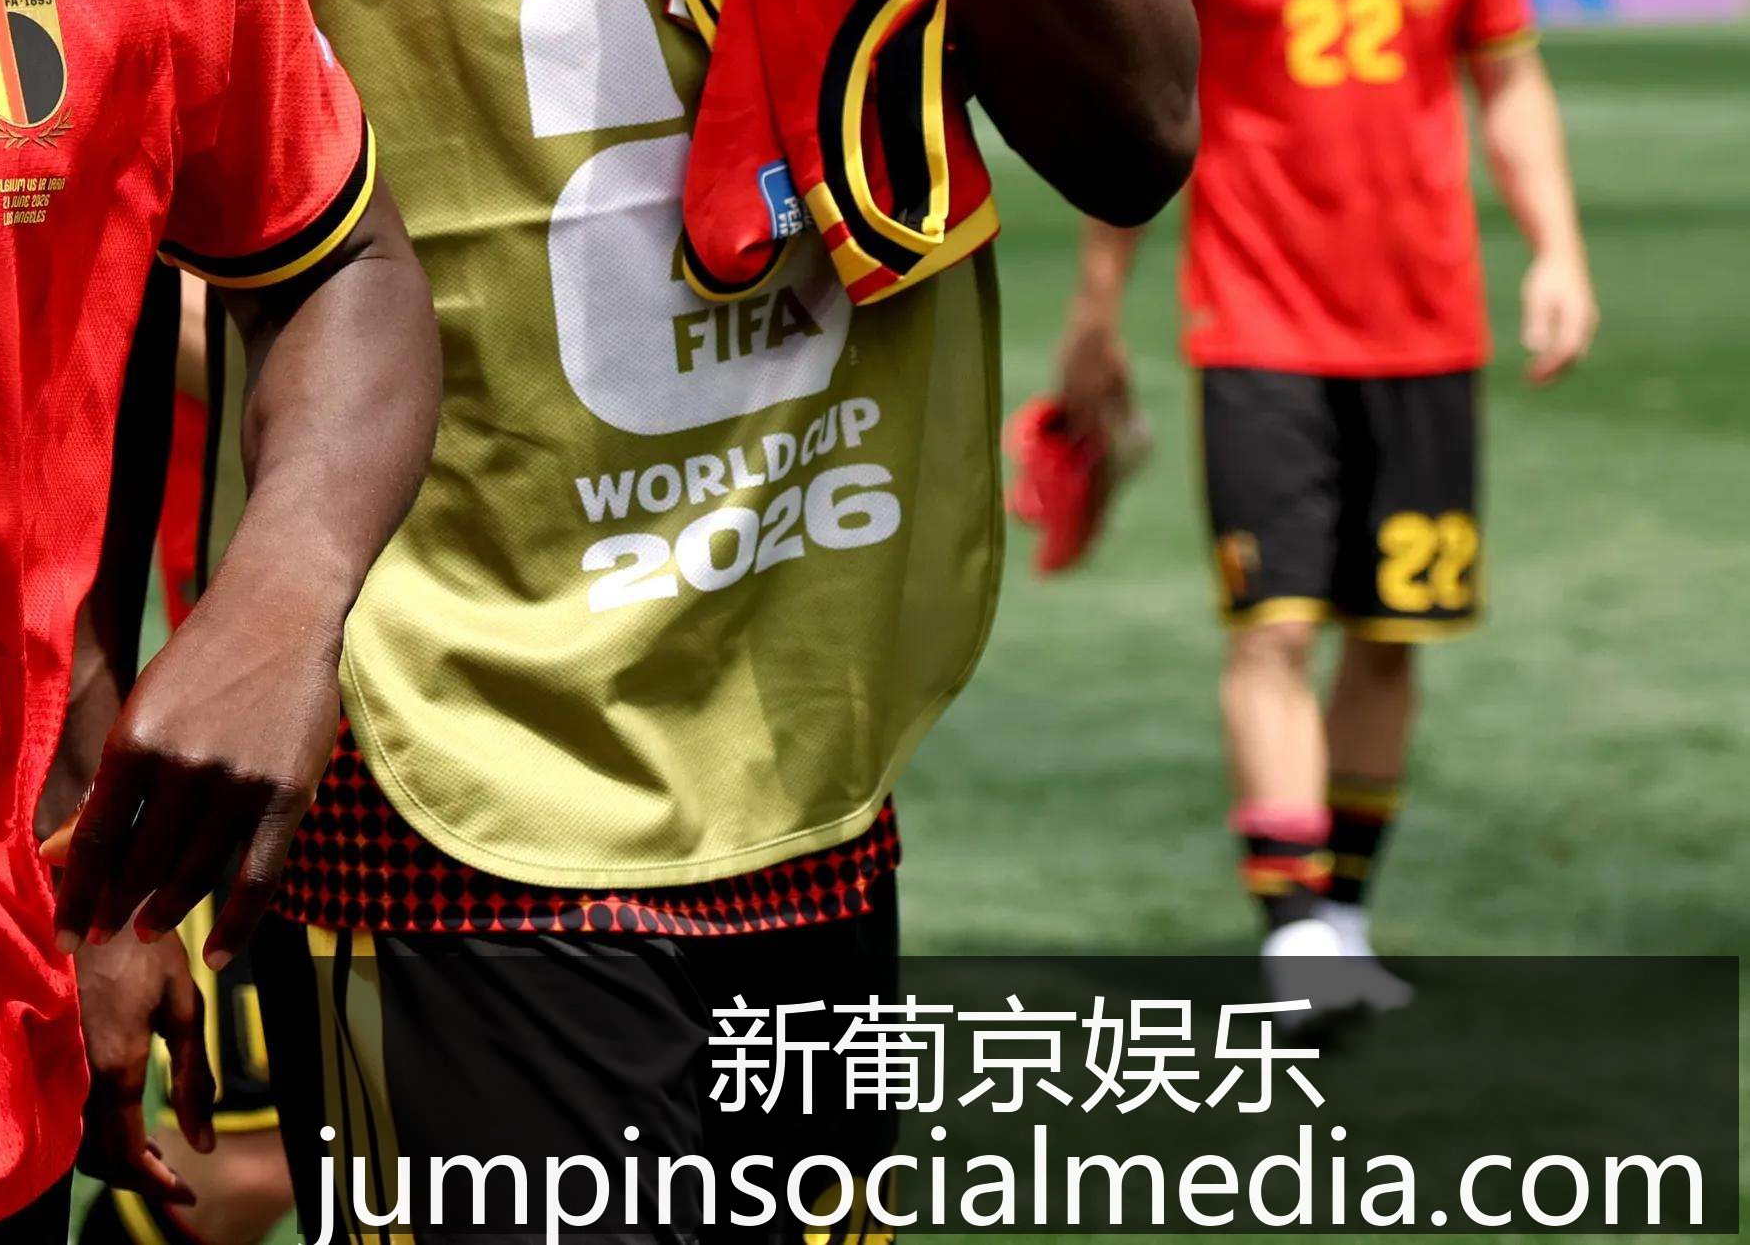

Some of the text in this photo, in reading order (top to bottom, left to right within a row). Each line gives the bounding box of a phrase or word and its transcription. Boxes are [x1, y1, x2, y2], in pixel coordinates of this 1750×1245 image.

[2, 195, 10, 209] 21
[11, 194, 30, 208] JUNE
[3, 209, 46, 226] LOS ANGELES
[672, 286, 824, 375] FIFA
[575, 397, 881, 523] WORLD CUP
[581, 463, 902, 614] 2026
[1376, 510, 1479, 613] 22
